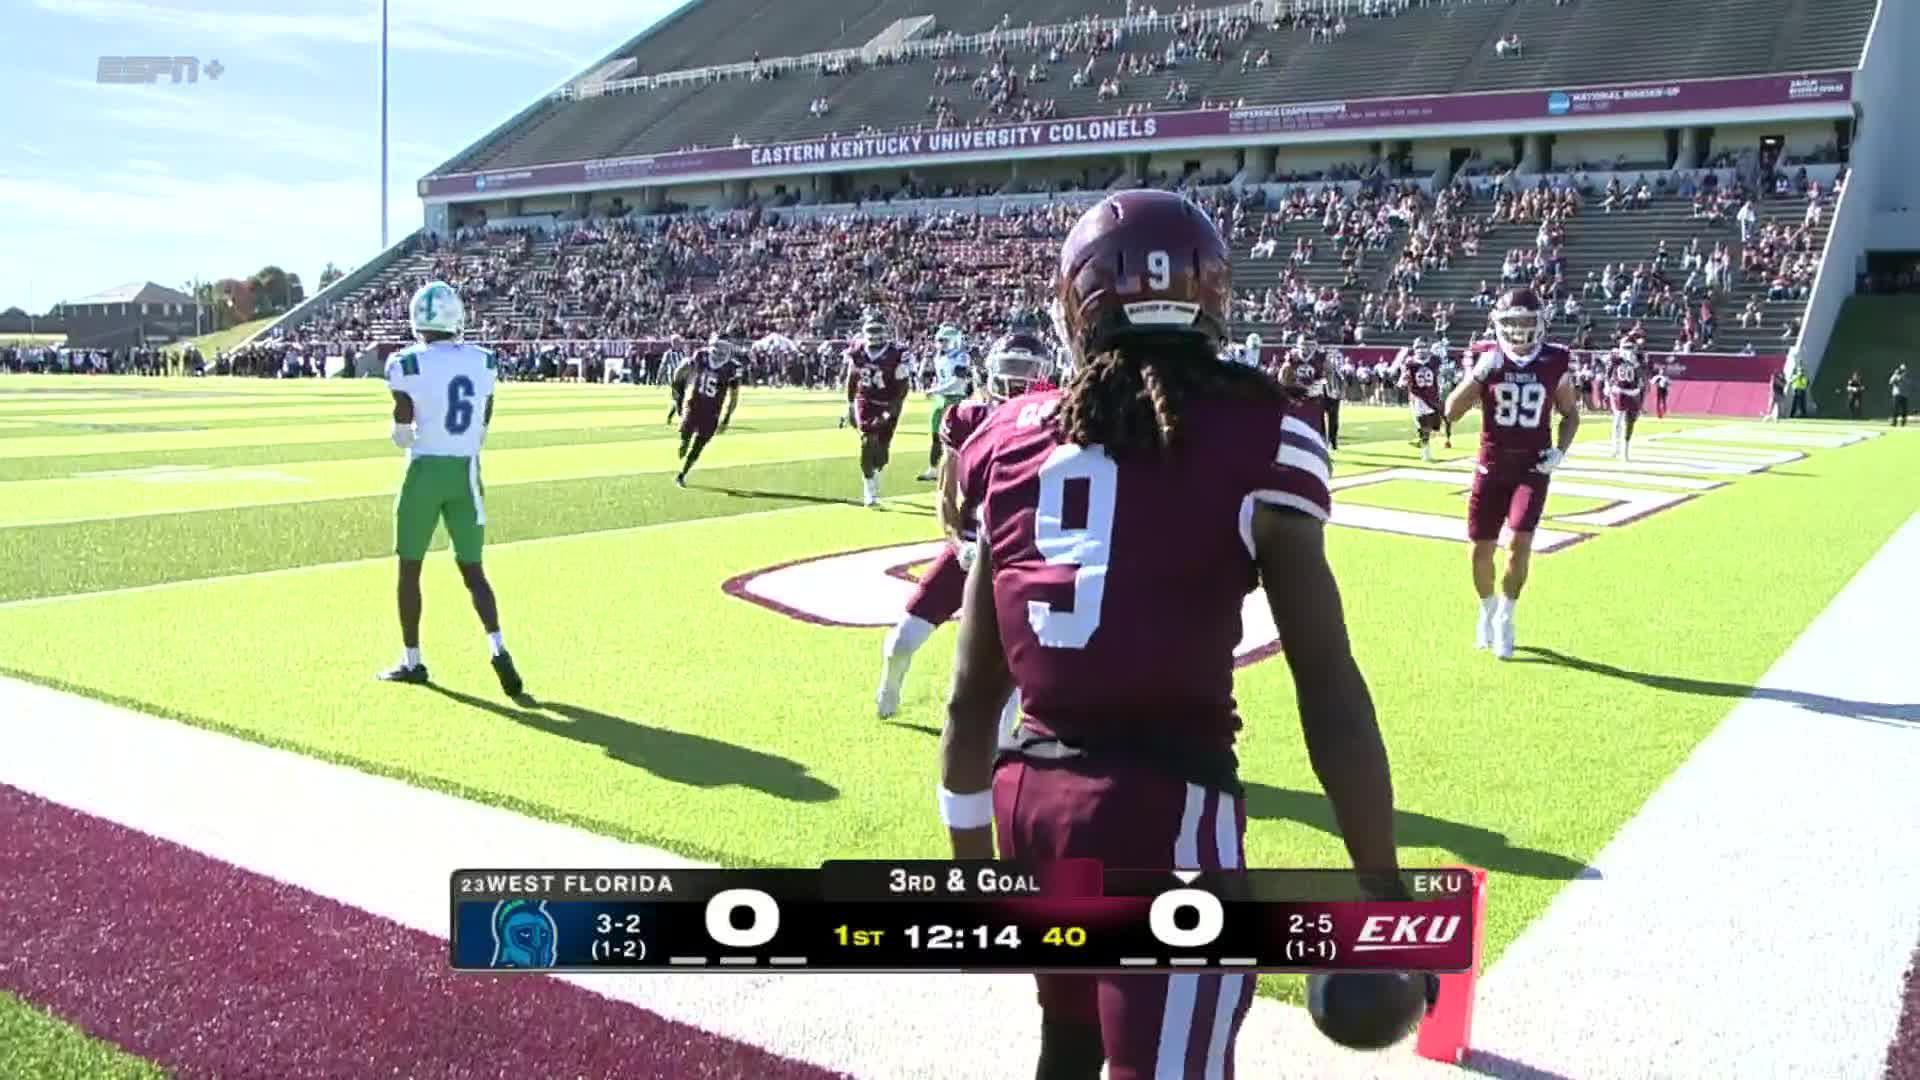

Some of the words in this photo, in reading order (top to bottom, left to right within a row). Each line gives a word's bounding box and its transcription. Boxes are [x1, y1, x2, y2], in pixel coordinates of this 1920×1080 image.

[751, 144, 825, 165] EASTERN
[830, 136, 923, 158] KENTUCKY
[929, 126, 1042, 150] UNIVERSITY
[1048, 118, 1157, 142] COLONELS
[1147, 250, 1171, 290] 9
[445, 375, 475, 434] 6
[698, 372, 718, 398] 15
[1493, 383, 1546, 427] 89
[1027, 443, 1118, 648] 9
